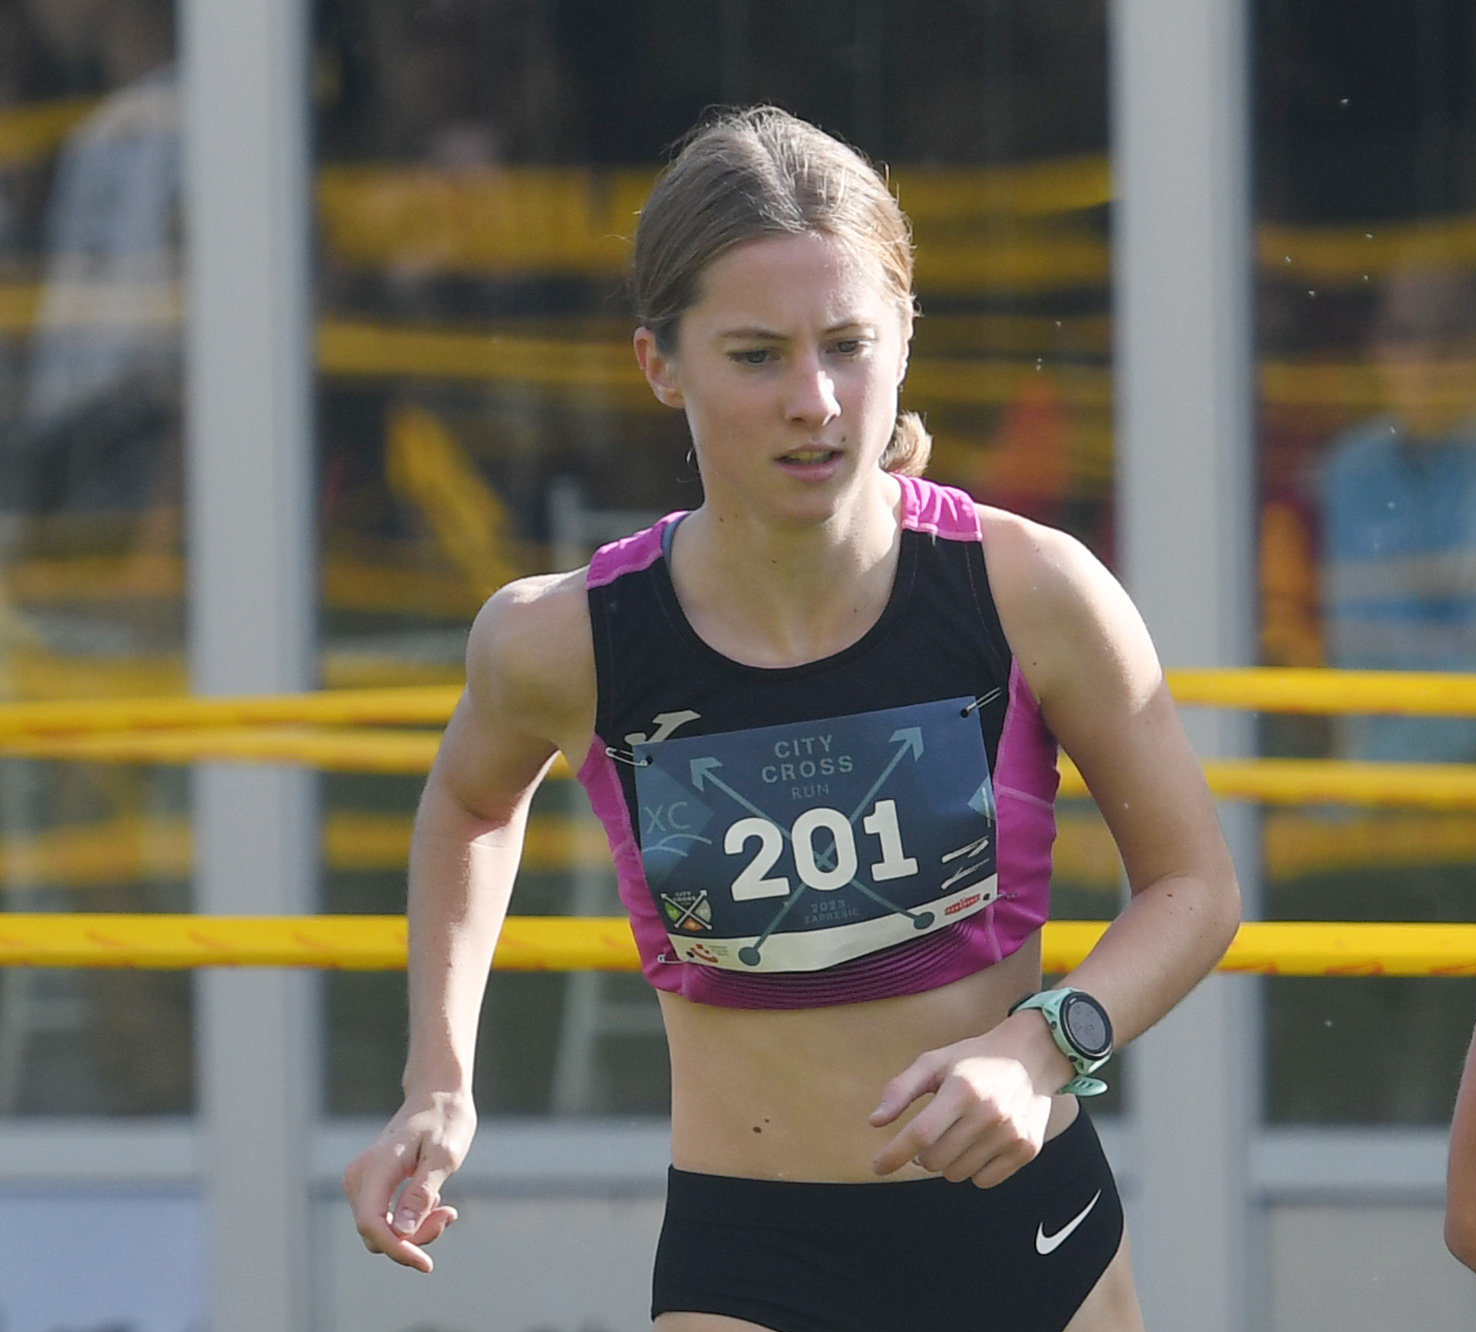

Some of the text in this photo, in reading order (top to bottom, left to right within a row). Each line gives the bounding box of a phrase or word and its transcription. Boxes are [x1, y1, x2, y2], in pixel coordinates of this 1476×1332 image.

[774, 734, 833, 759] CITY
[761, 755, 853, 783] CROSS
[791, 783, 830, 800] RUN
[644, 801, 690, 834] XC
[724, 799, 918, 901] 201
